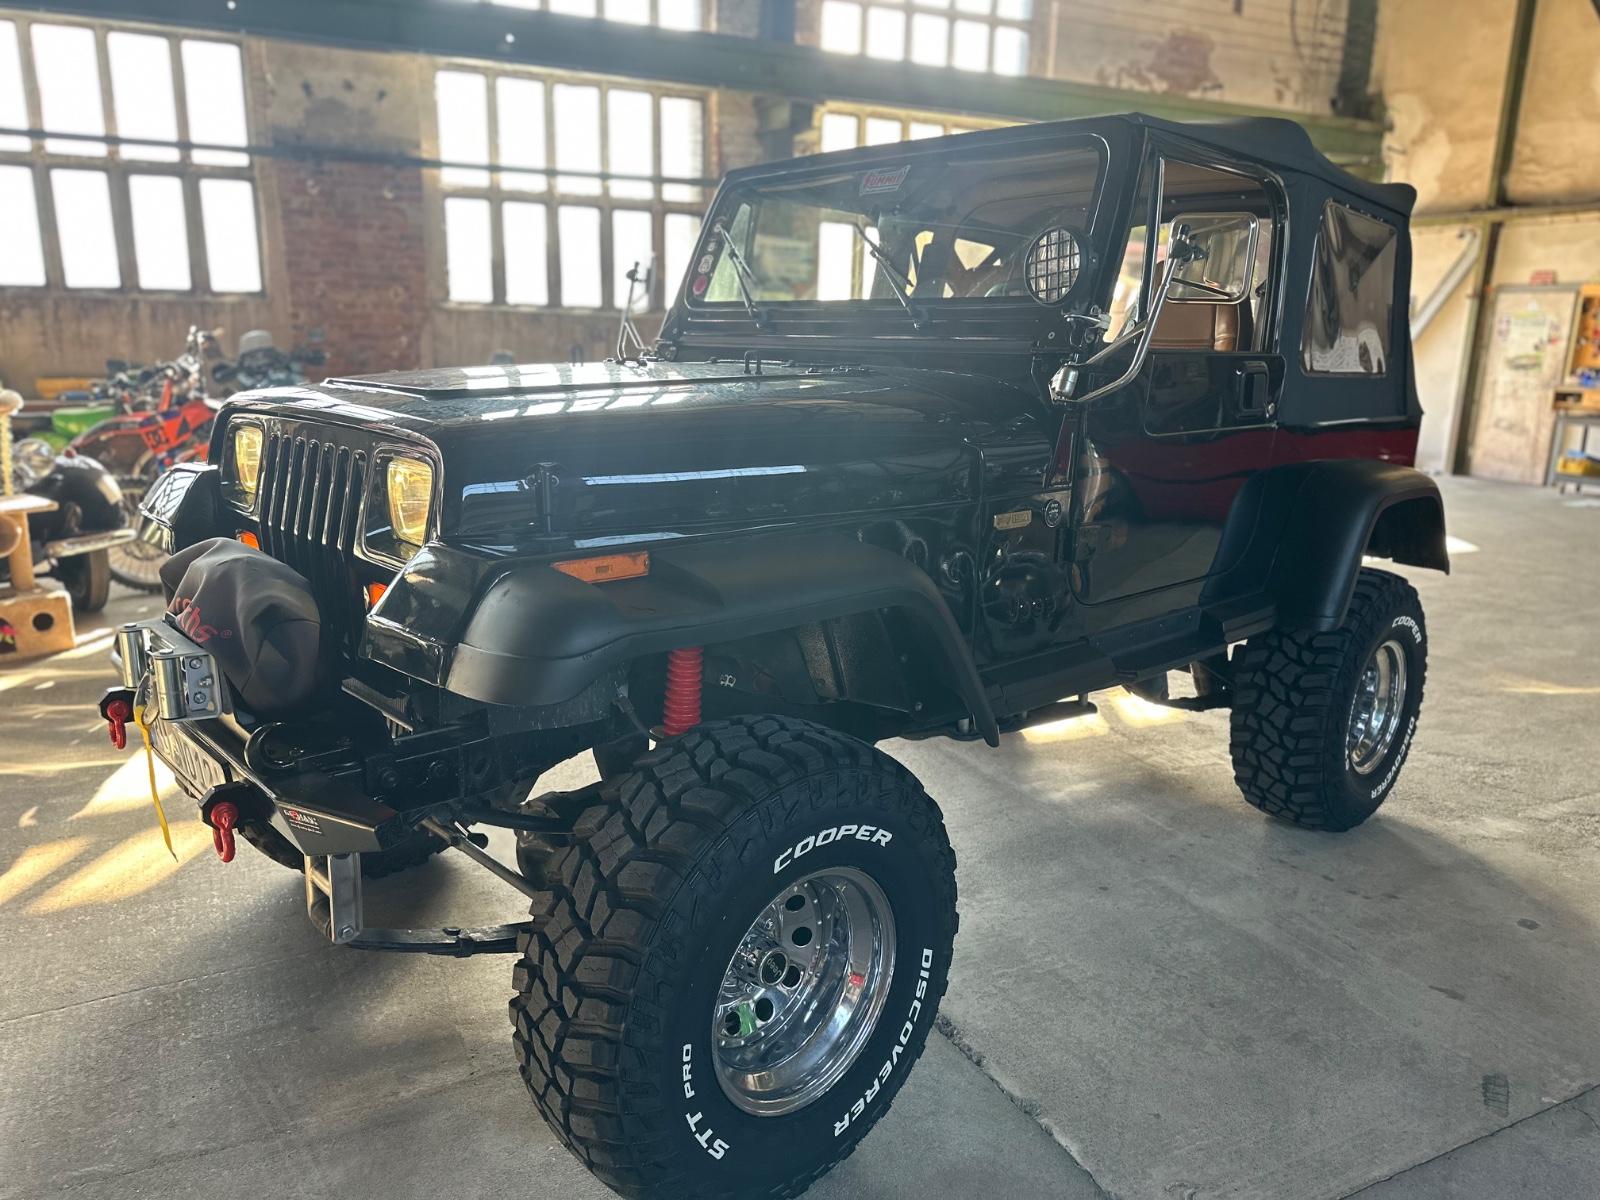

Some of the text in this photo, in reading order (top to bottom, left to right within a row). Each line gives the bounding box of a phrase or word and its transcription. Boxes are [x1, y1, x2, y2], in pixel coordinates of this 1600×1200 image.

[1392, 615, 1422, 644] COOPER
[1371, 716, 1416, 799] DISCOVERER
[773, 823, 893, 875] COOPER
[766, 957, 782, 978] Jeep
[833, 948, 933, 1137] DISCOVERER
[682, 1043, 730, 1160] STT PRO
